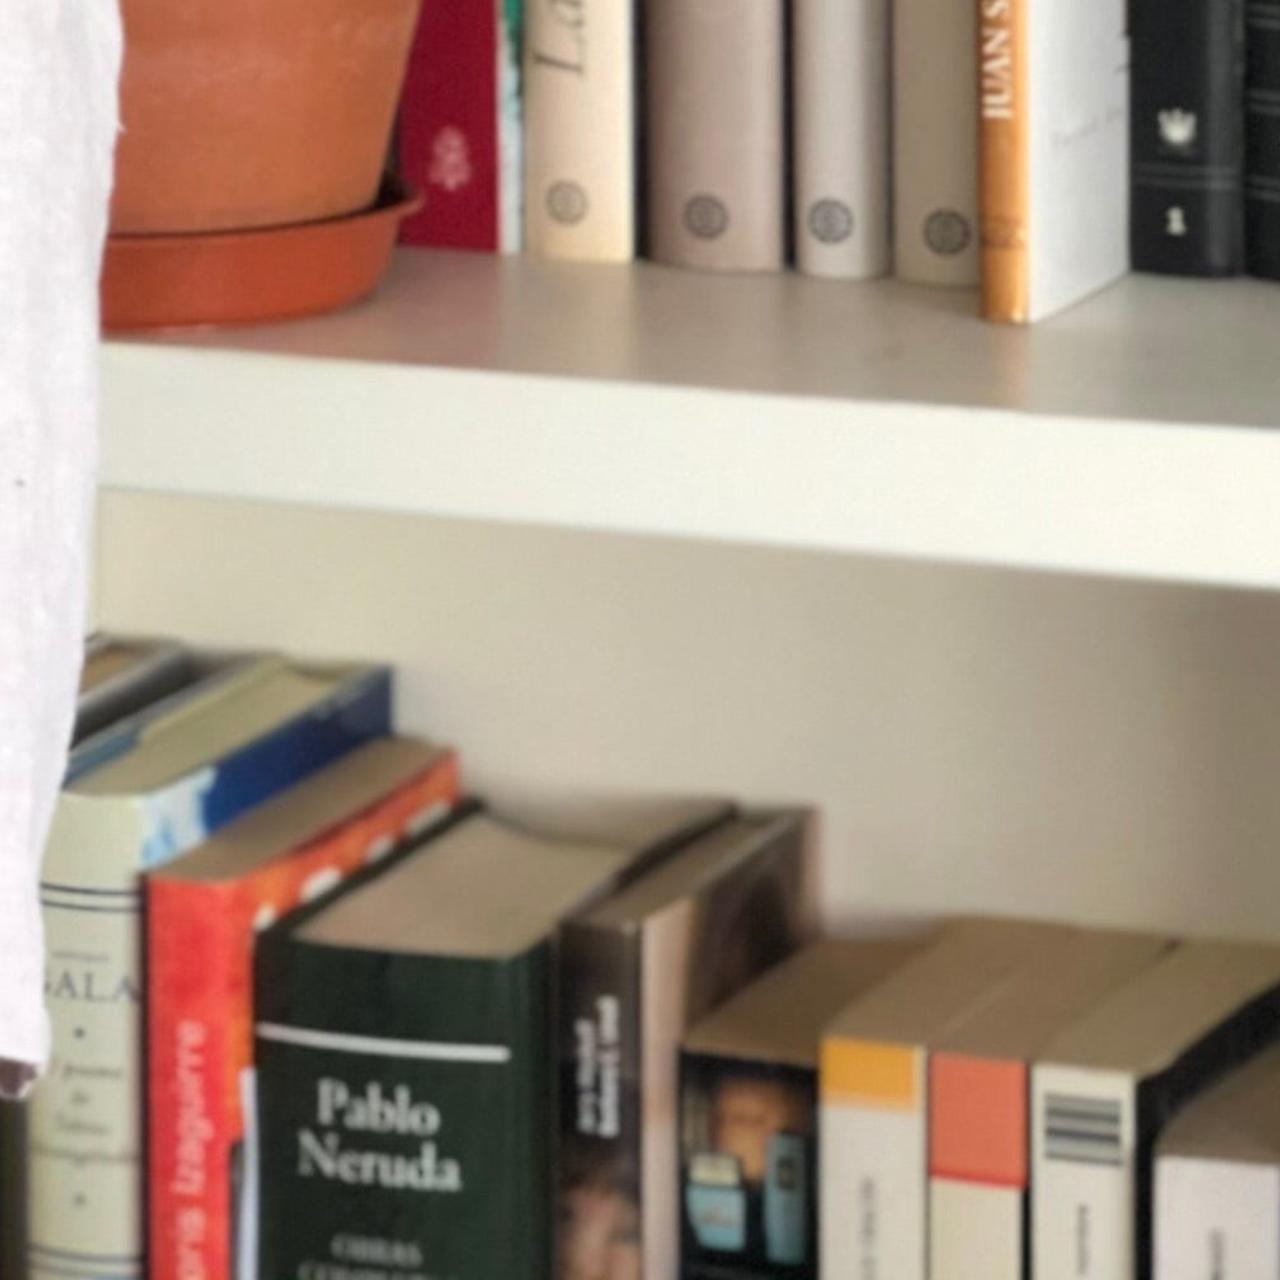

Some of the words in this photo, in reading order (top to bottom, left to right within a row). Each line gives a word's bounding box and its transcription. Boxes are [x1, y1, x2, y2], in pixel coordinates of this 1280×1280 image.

[981, 21, 1014, 120] JUAN
[44, 970, 141, 1004] ALA
[171, 1020, 213, 1195] Izaguirre
[317, 1077, 441, 1136] Pablo
[298, 1127, 462, 1192] Neruda
